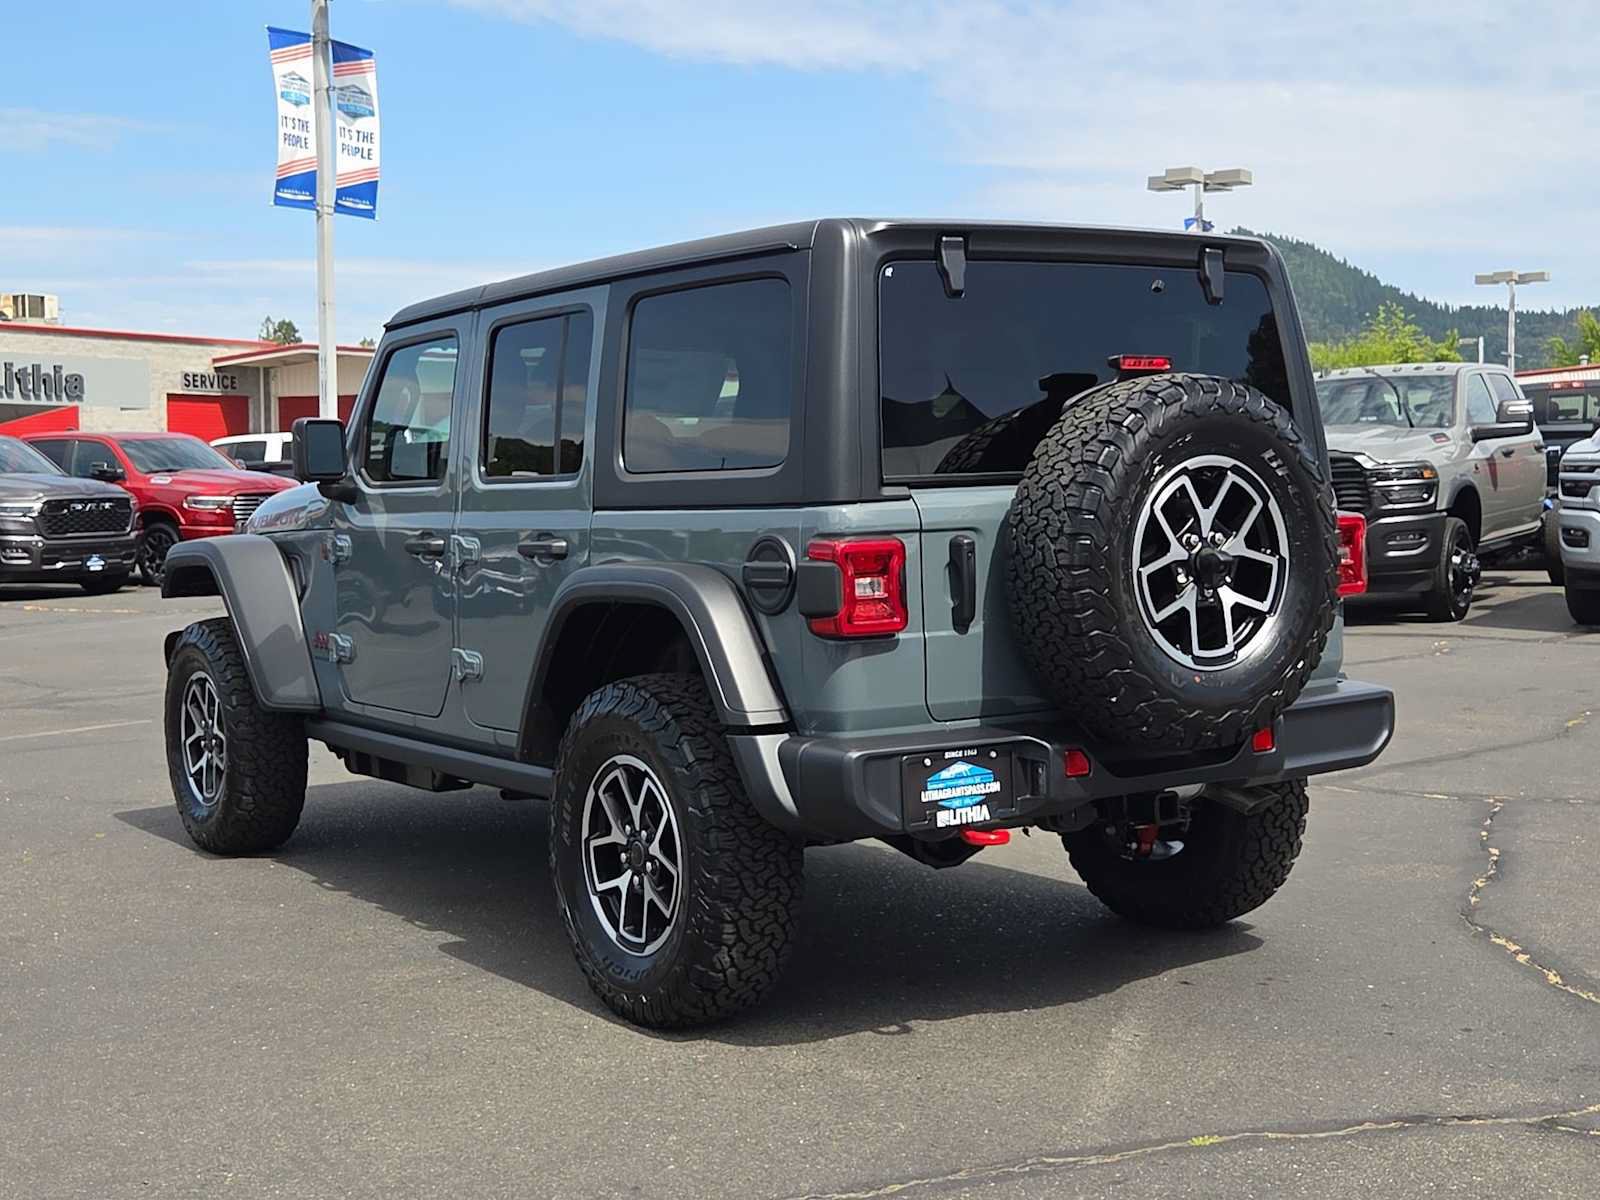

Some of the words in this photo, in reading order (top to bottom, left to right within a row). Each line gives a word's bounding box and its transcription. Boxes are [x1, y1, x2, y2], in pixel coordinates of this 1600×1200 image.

[297, 118, 310, 133] THE
[283, 132, 309, 149] PEOPLE
[355, 130, 375, 144] THE
[341, 143, 373, 160] PEOPLE
[0, 362, 85, 402] ithia
[183, 372, 238, 390] SERVICE
[949, 804, 991, 826] LITHIA
